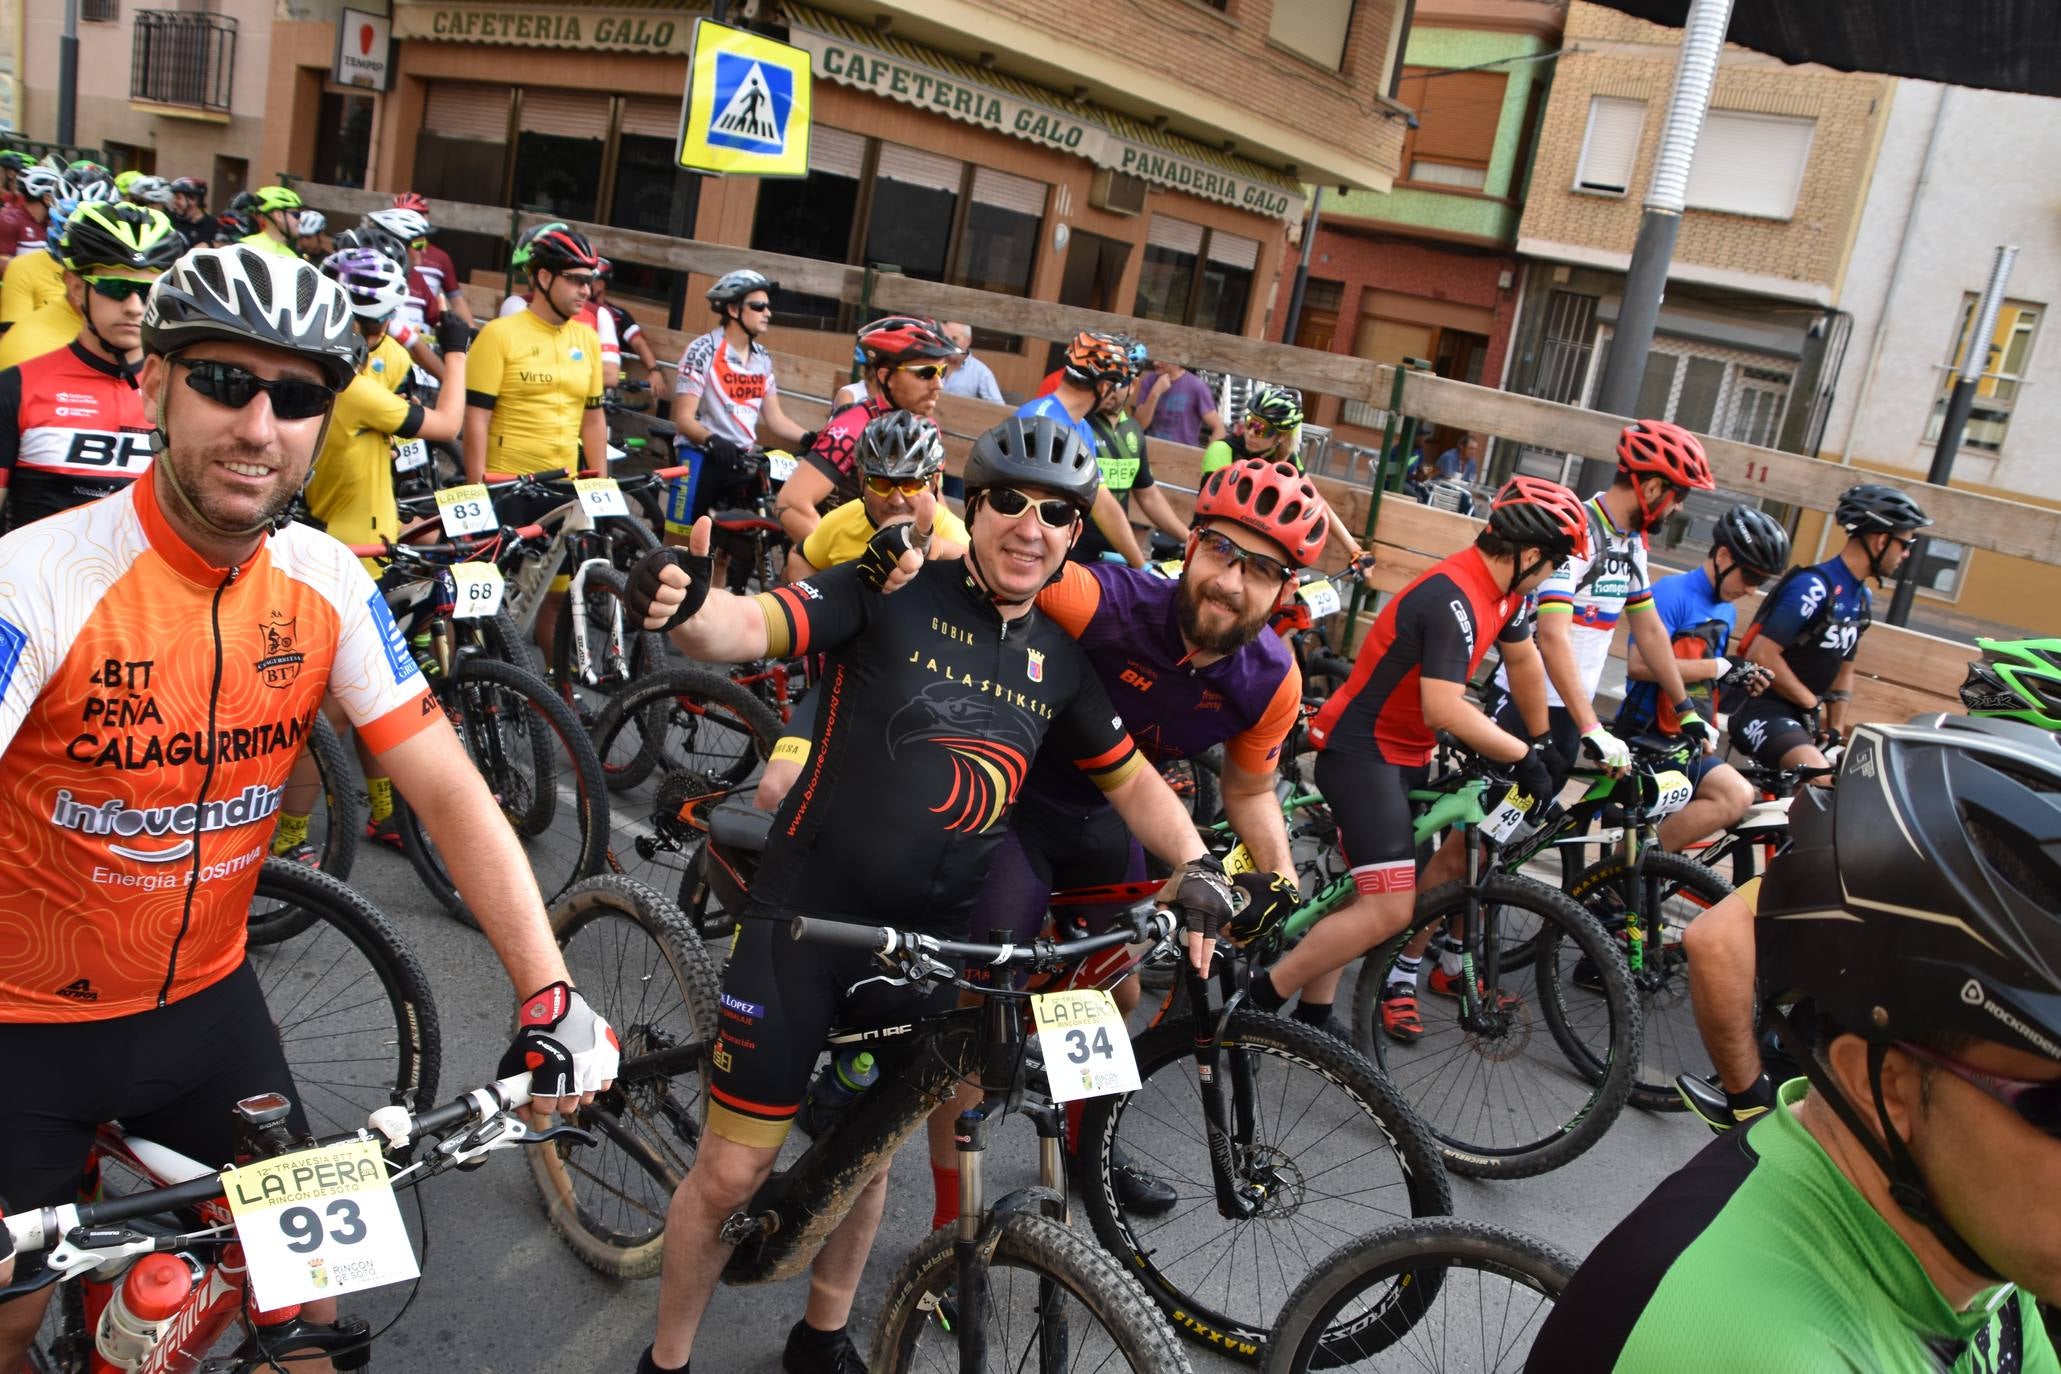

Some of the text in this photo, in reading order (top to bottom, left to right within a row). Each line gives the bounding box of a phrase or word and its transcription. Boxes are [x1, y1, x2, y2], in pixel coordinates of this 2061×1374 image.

[432, 11, 676, 48] CAFETERIA GALO
[822, 46, 1084, 148] CAFETERIA GALO
[1121, 146, 1289, 215] PANADERIA GALO
[520, 371, 553, 383] Virto
[723, 373, 764, 384] CICLOS
[730, 386, 762, 399] LOPEZ
[1745, 462, 1770, 483] 11
[591, 491, 611, 503] 61
[453, 502, 481, 519] 83
[470, 583, 492, 600] 68
[931, 616, 974, 646] GOBIK
[909, 651, 1053, 720] JALASBIKERS
[1120, 668, 1153, 692] BH
[82, 693, 164, 728] PEÑA
[1662, 787, 1689, 806] 199
[1501, 808, 1521, 826] 49
[92, 866, 176, 892] Energía
[726, 994, 754, 1014] LOPEZ
[1040, 1004, 1068, 1024] LA
[1065, 1026, 1113, 1064] 34
[276, 1156, 330, 1173] TRAVESIA
[333, 1152, 353, 1163] BTT
[235, 1158, 380, 1205] LA PERA
[314, 1189, 326, 1198] DE
[329, 1183, 359, 1195] SOTO
[279, 1198, 368, 1254] 93
[332, 1259, 374, 1275] RINCON
[1172, 1310, 1257, 1355] MAXXIS
